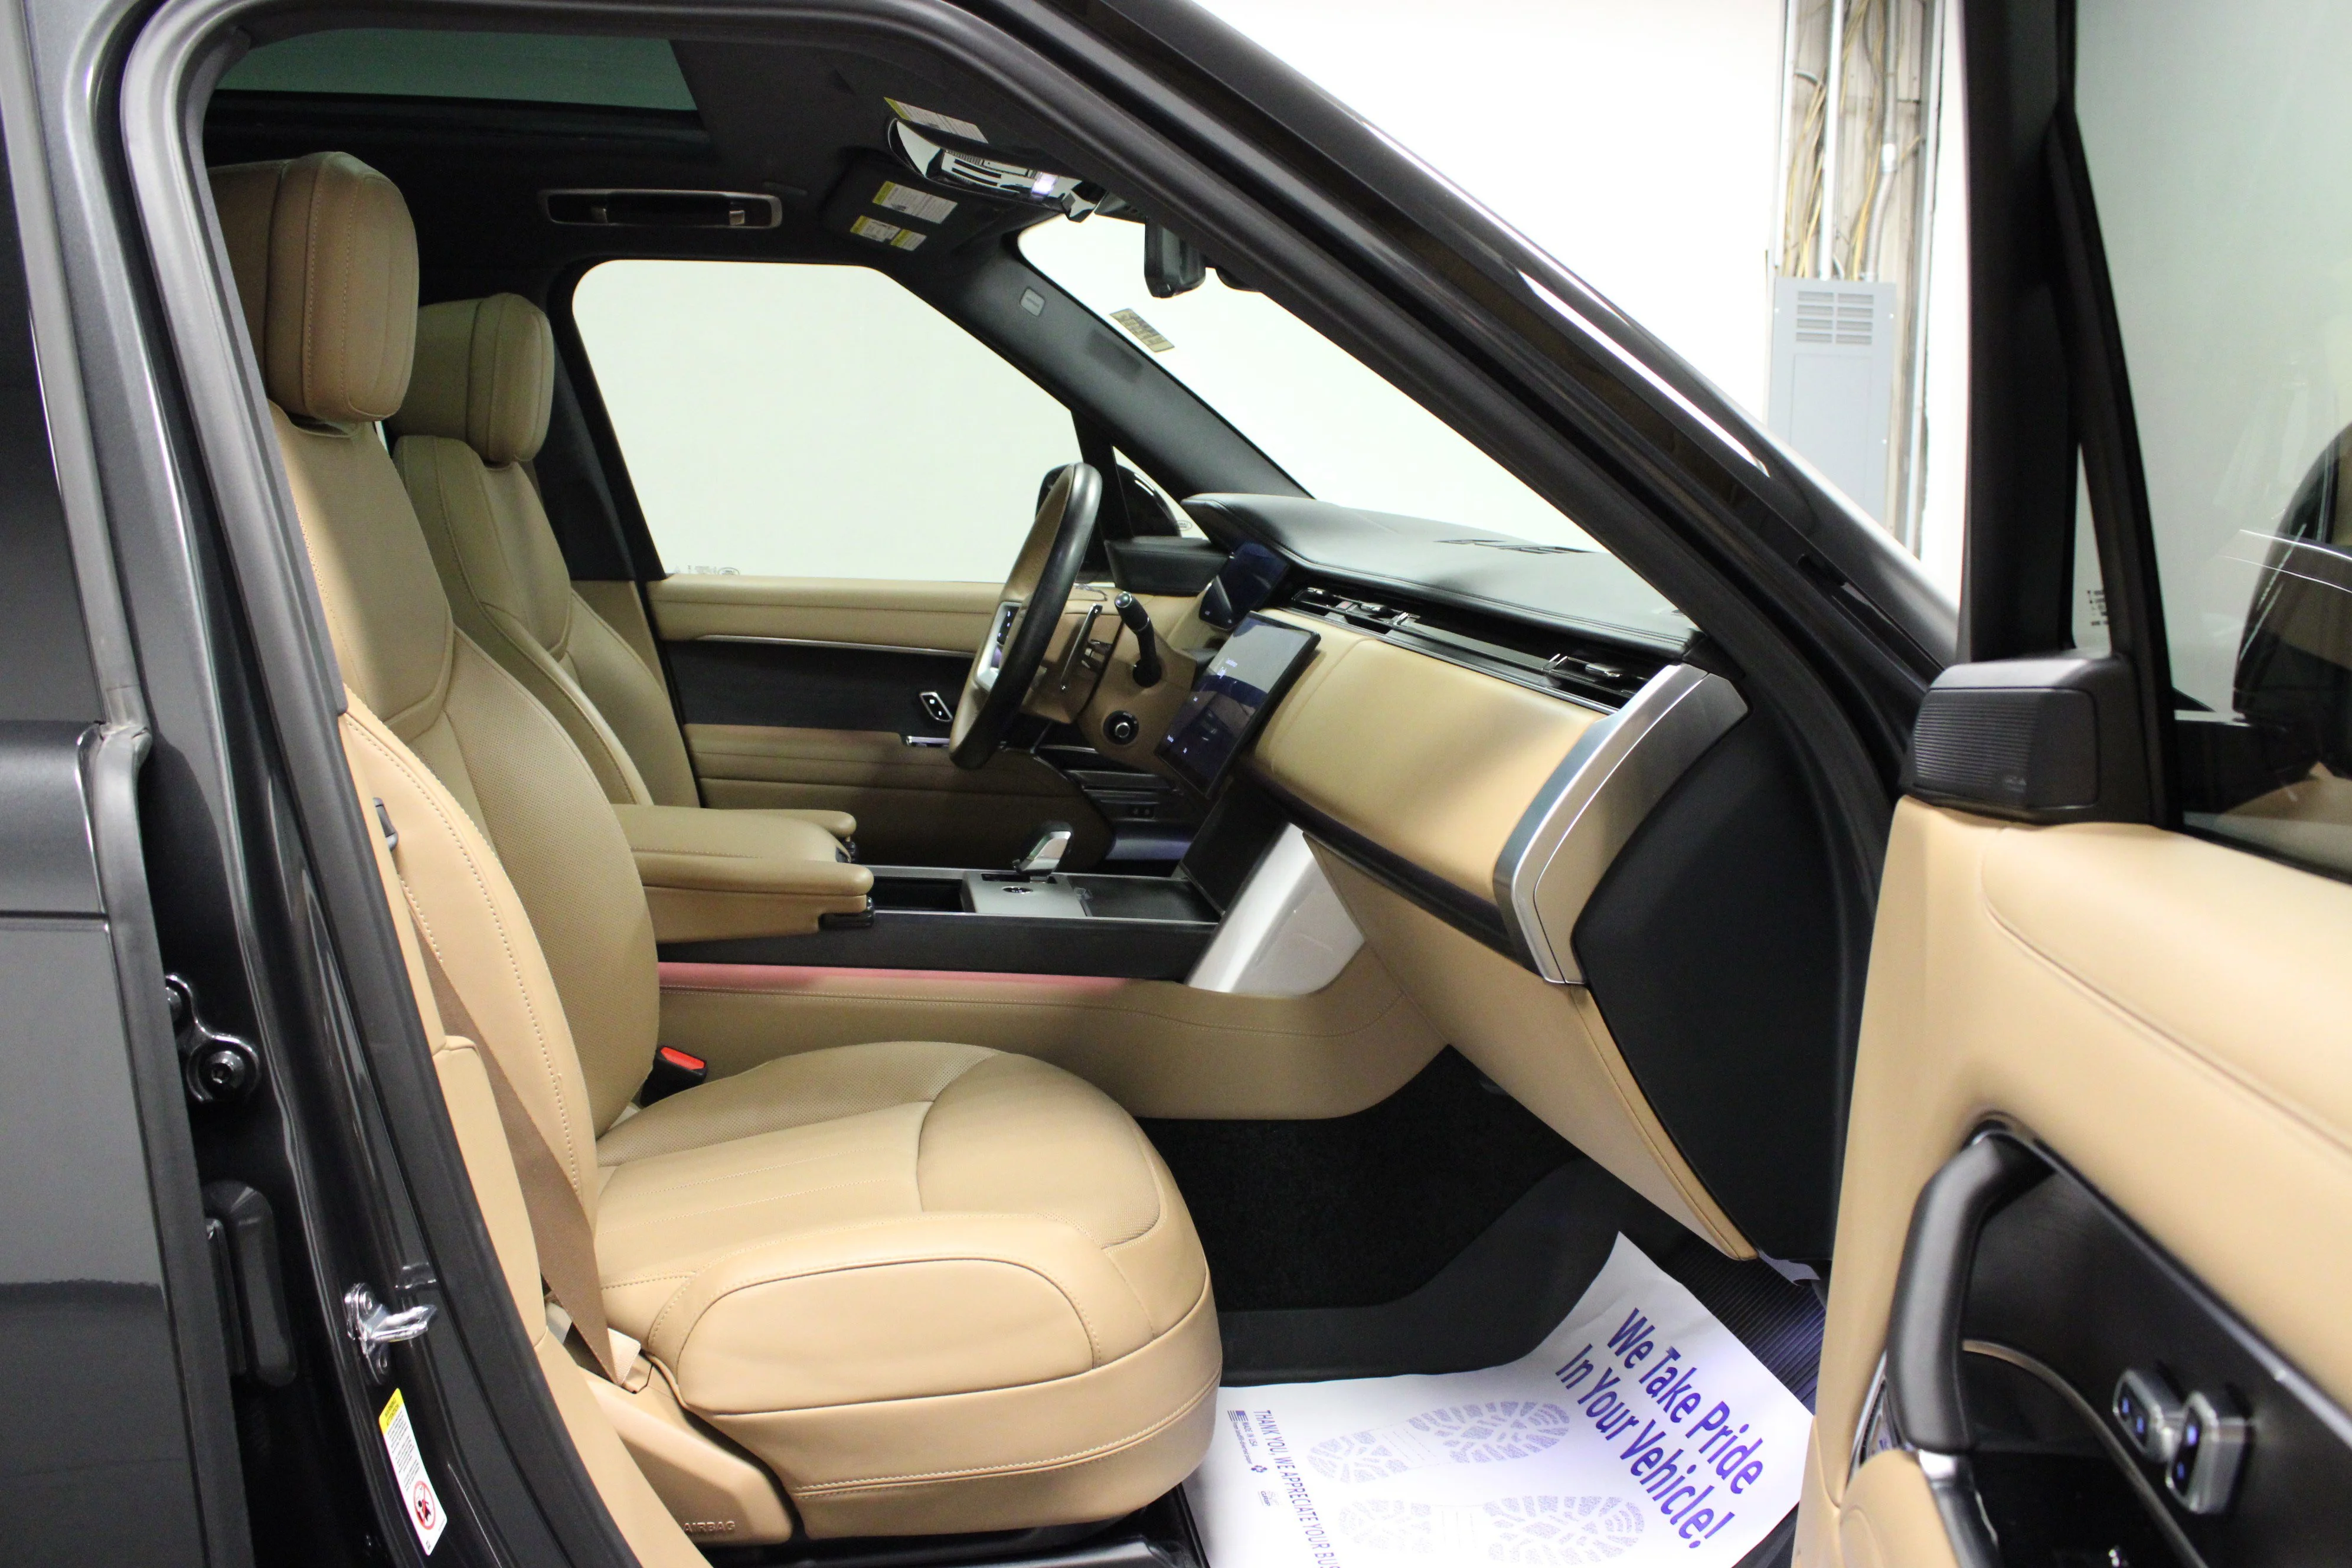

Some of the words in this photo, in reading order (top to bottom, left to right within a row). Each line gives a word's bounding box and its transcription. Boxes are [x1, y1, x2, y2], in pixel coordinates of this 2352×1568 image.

[1608, 1307, 1655, 1369] We
[1639, 1345, 1701, 1423] Take
[1685, 1400, 1763, 1494] Pride
[1253, 1410, 1280, 1435] THANK
[1555, 1344, 1594, 1390] In
[1577, 1367, 1639, 1440] Your
[1620, 1419, 1735, 1549] Vehicle!
[1274, 1456, 1295, 1469] WE
[1260, 1491, 1270, 1507] GRIP
[1279, 1471, 1318, 1522] APPRECIATE
[683, 1521, 736, 1533] AIRBAG
[1302, 1523, 1330, 1549] YOUR
